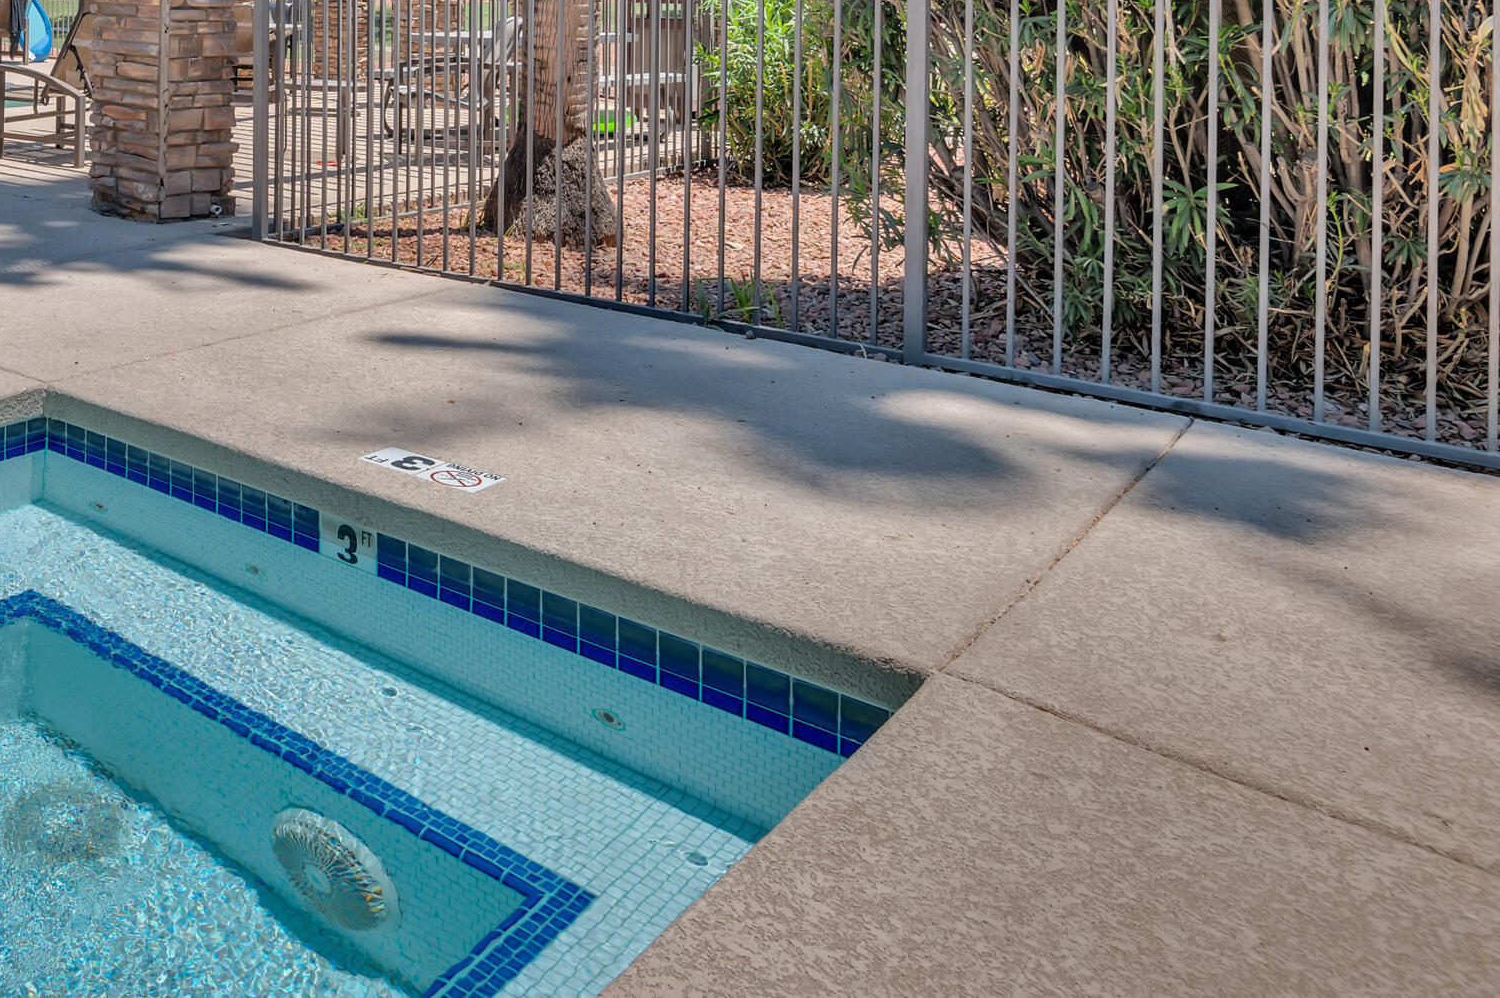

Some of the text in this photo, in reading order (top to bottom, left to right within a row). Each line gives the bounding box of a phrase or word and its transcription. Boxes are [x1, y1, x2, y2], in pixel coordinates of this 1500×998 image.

[364, 455, 436, 471] 3 FT
[446, 463, 484, 475] DIVING
[337, 524, 372, 565] 3 FT
